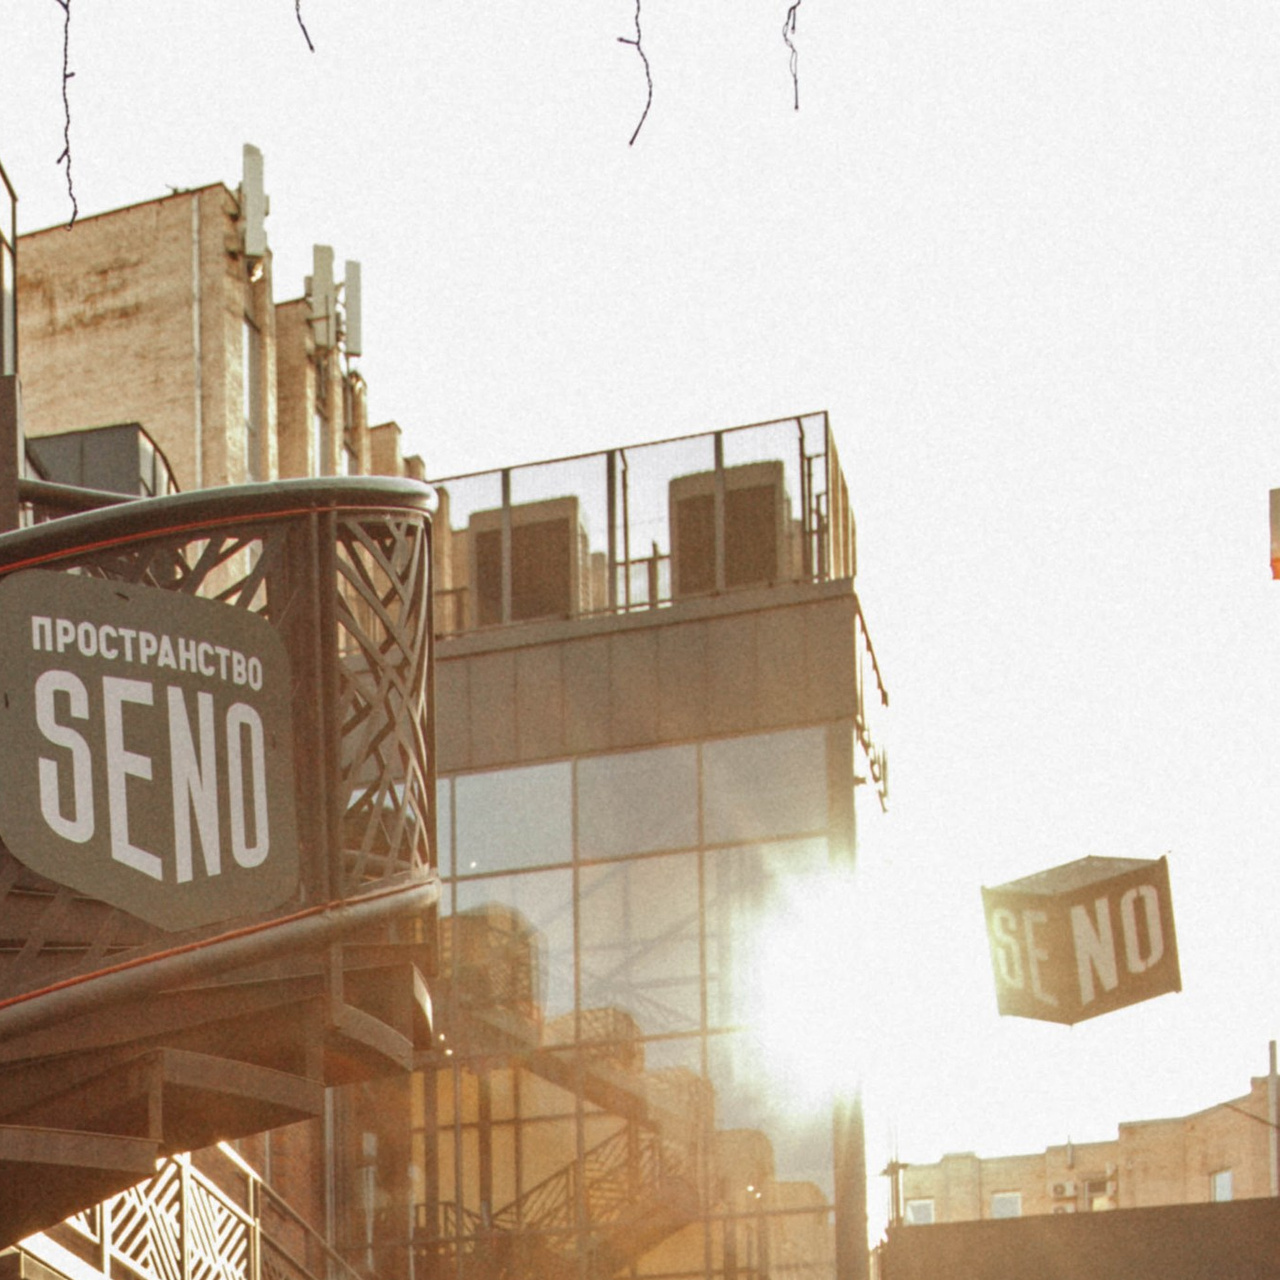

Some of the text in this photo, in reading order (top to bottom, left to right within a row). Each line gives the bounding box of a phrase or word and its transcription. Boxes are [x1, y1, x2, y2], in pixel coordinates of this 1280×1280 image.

[31, 616, 263, 691] ПРОСТРАНСТВО
[35, 669, 269, 884] SENO
[991, 884, 1164, 1007] SENO
